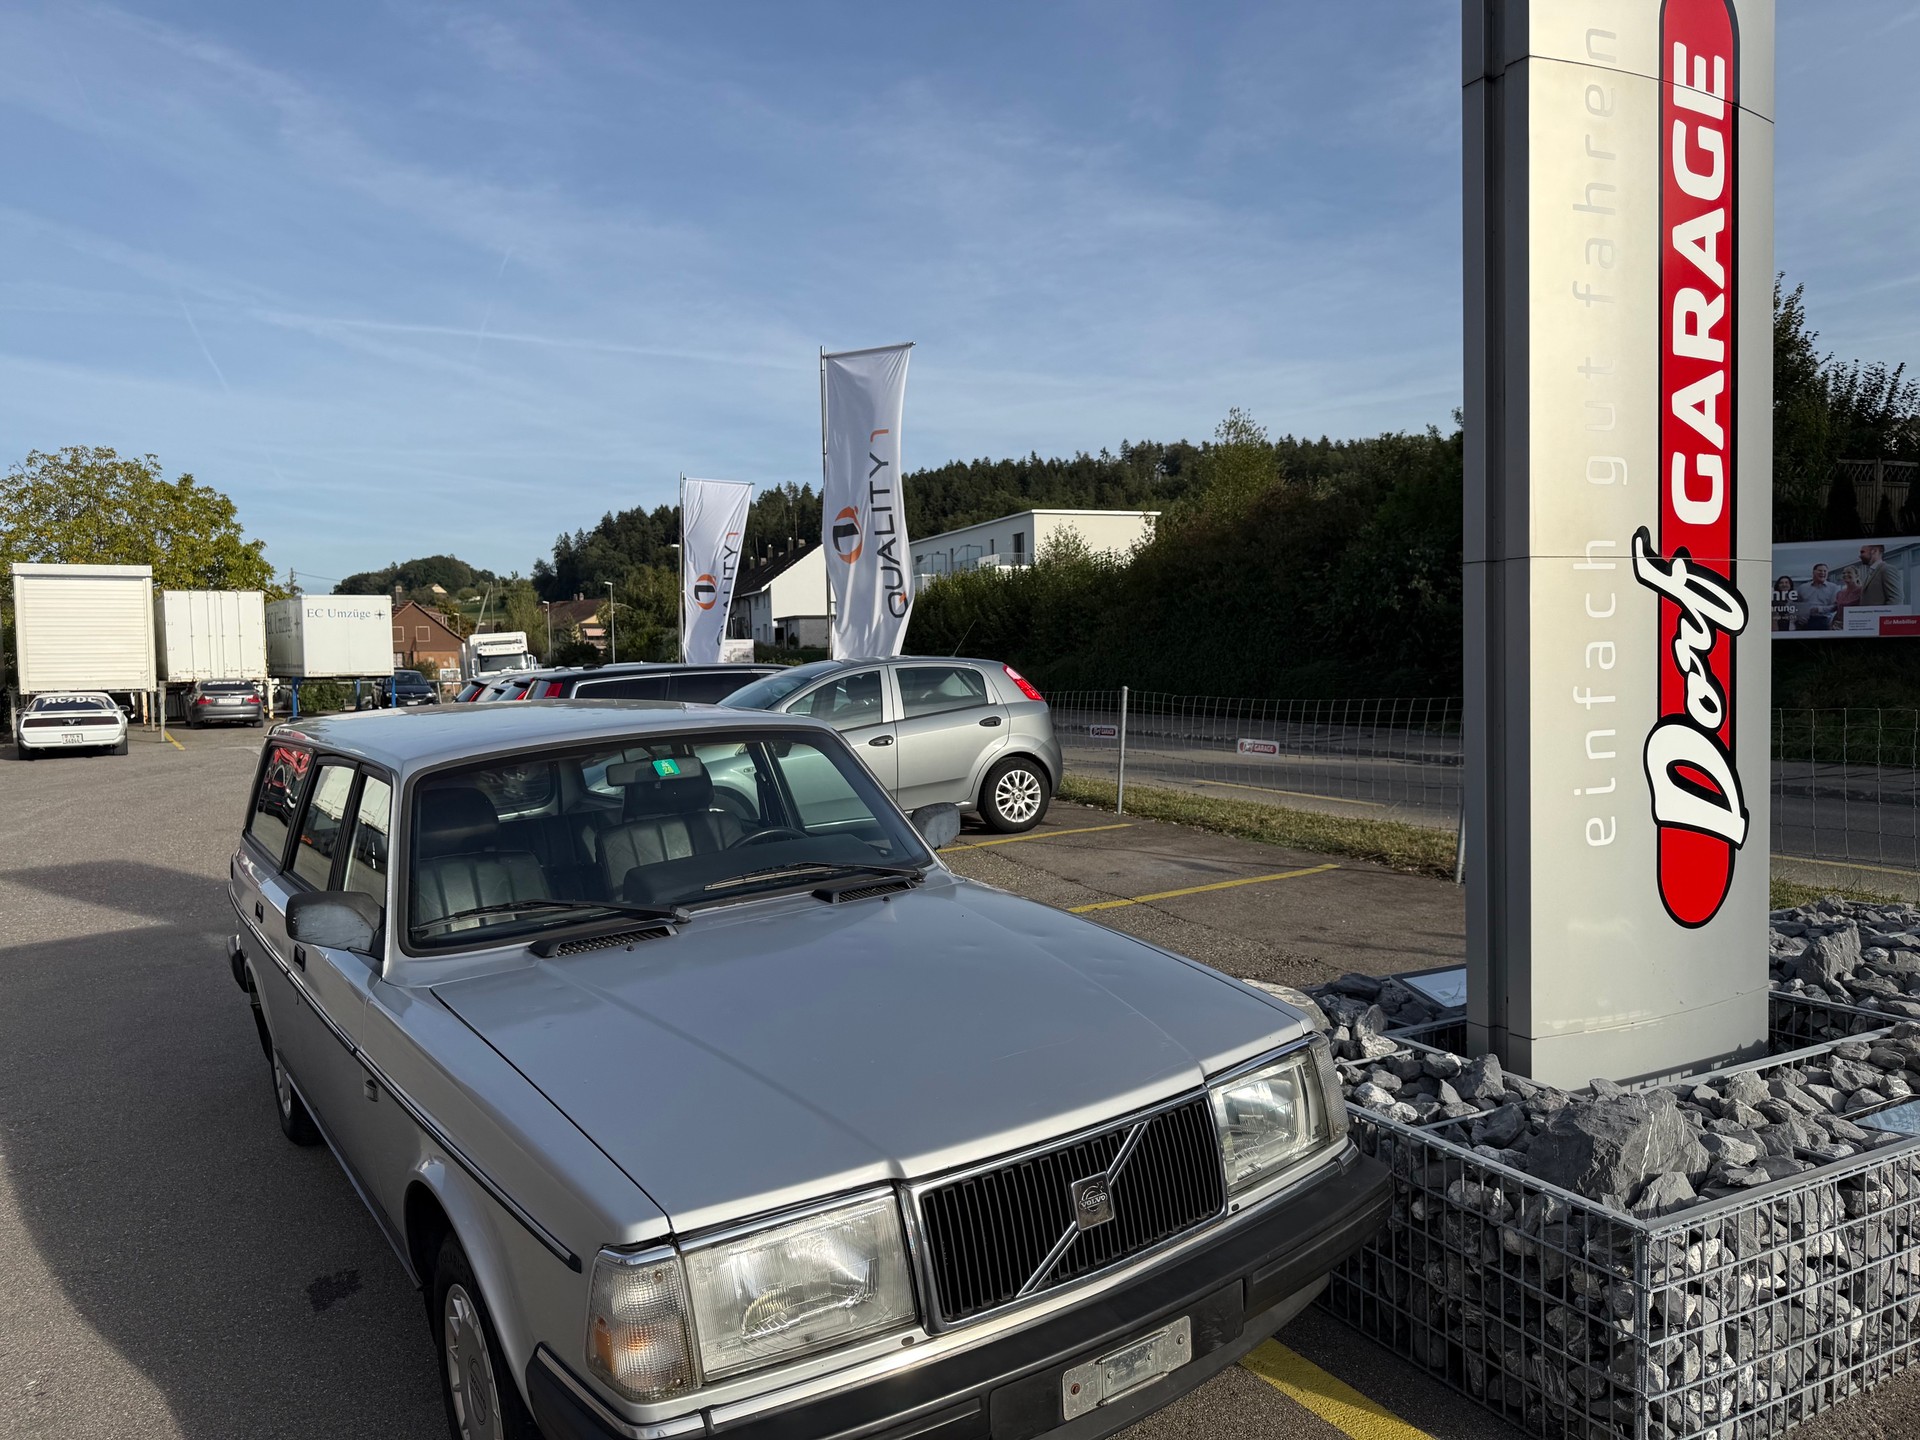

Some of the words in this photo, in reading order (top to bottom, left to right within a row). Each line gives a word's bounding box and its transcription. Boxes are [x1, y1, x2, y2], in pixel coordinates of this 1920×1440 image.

[1572, 27, 1617, 308] fahren
[1671, 41, 1725, 525] GARAGE
[1577, 356, 1628, 486] gut
[306, 608, 324, 618] EC
[327, 608, 371, 620] Umzüge
[1573, 539, 1617, 847] einfach
[1633, 530, 1748, 848] Dorf
[1081, 1195, 1106, 1207] VOLVO
